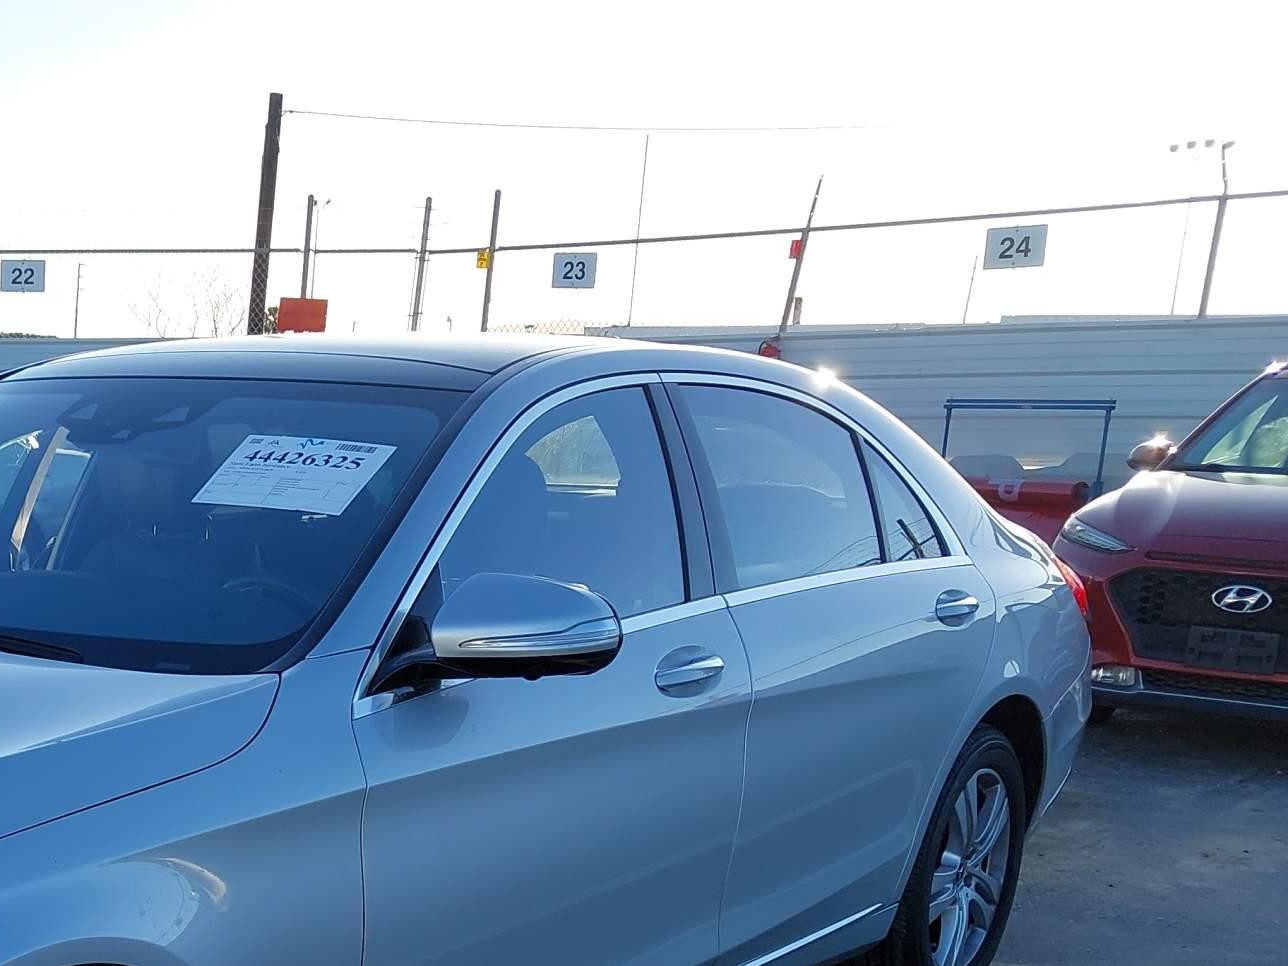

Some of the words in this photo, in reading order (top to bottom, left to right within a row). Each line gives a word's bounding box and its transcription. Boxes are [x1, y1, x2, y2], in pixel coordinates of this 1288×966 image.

[998, 236, 1031, 259] 24
[11, 268, 34, 284] 22
[562, 261, 586, 280] 23
[244, 449, 366, 470] 44426325
